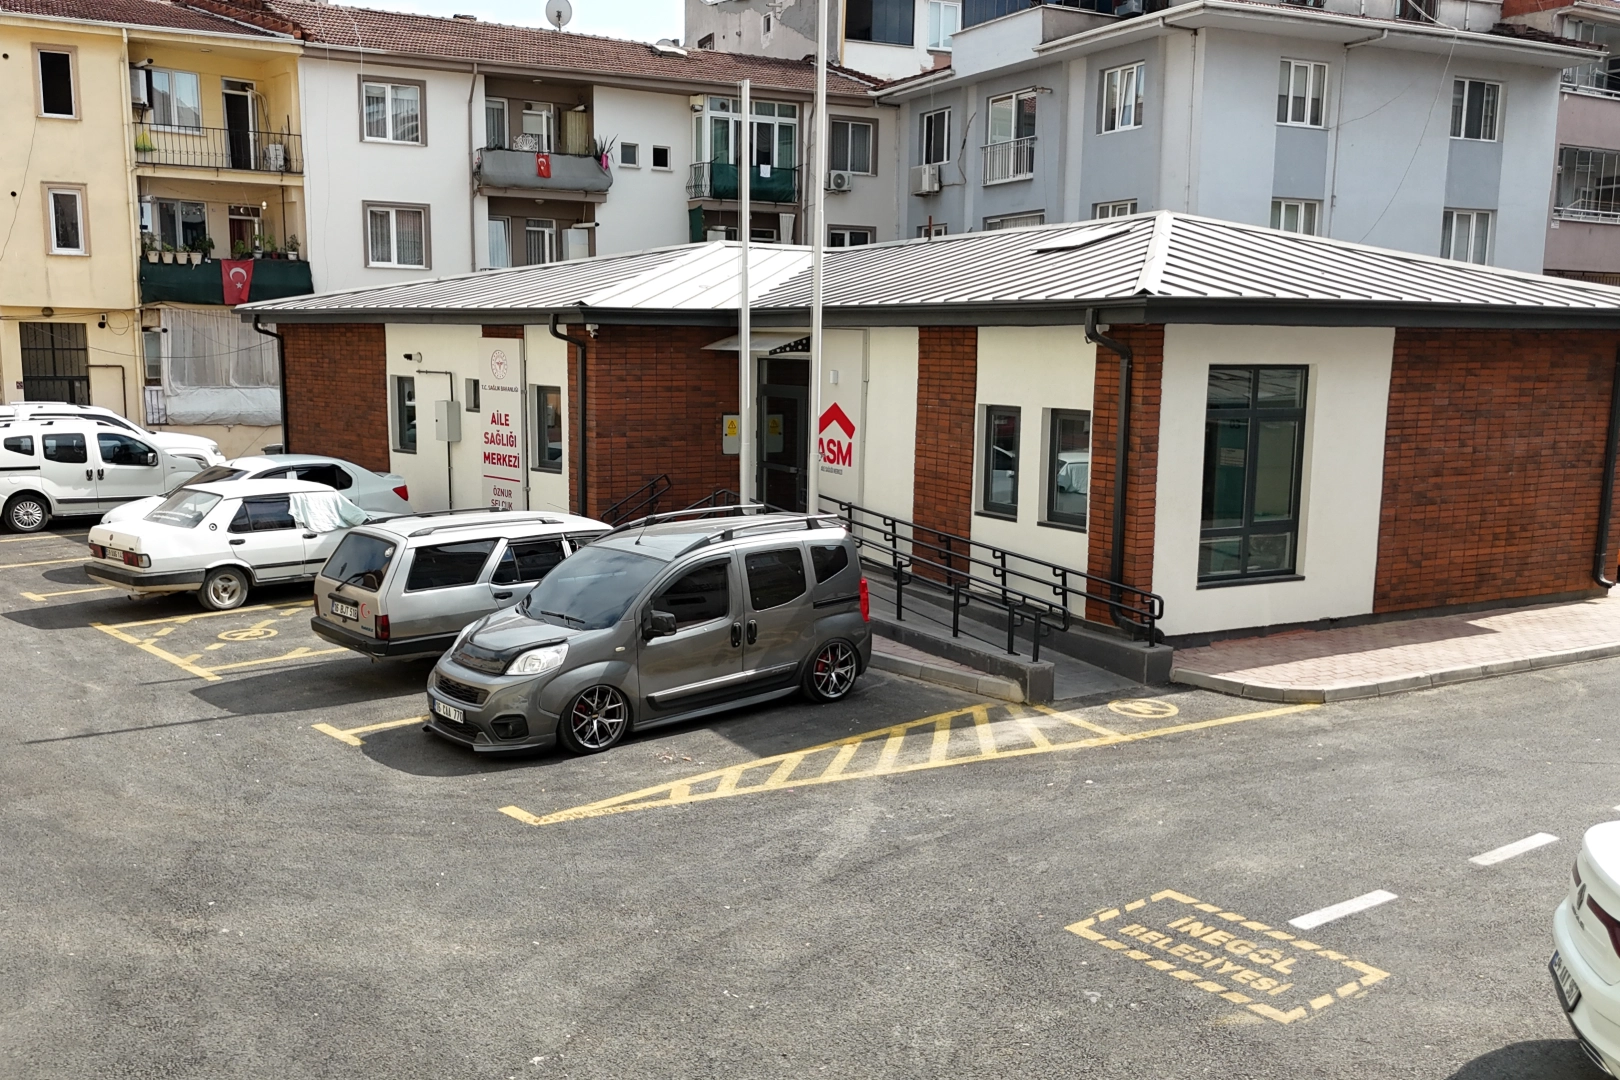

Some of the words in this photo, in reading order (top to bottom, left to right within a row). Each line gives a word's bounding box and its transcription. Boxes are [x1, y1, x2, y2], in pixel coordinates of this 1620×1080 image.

[490, 410, 510, 427] AİLE
[483, 430, 517, 448] SAĞLIĞI
[483, 452, 520, 469] MERKEZİ
[818, 437, 853, 467] ASM
[493, 484, 513, 499] ÖZNUR
[1167, 915, 1297, 975] İNEGÖL
[1118, 923, 1294, 996] BELEDİYESİ
